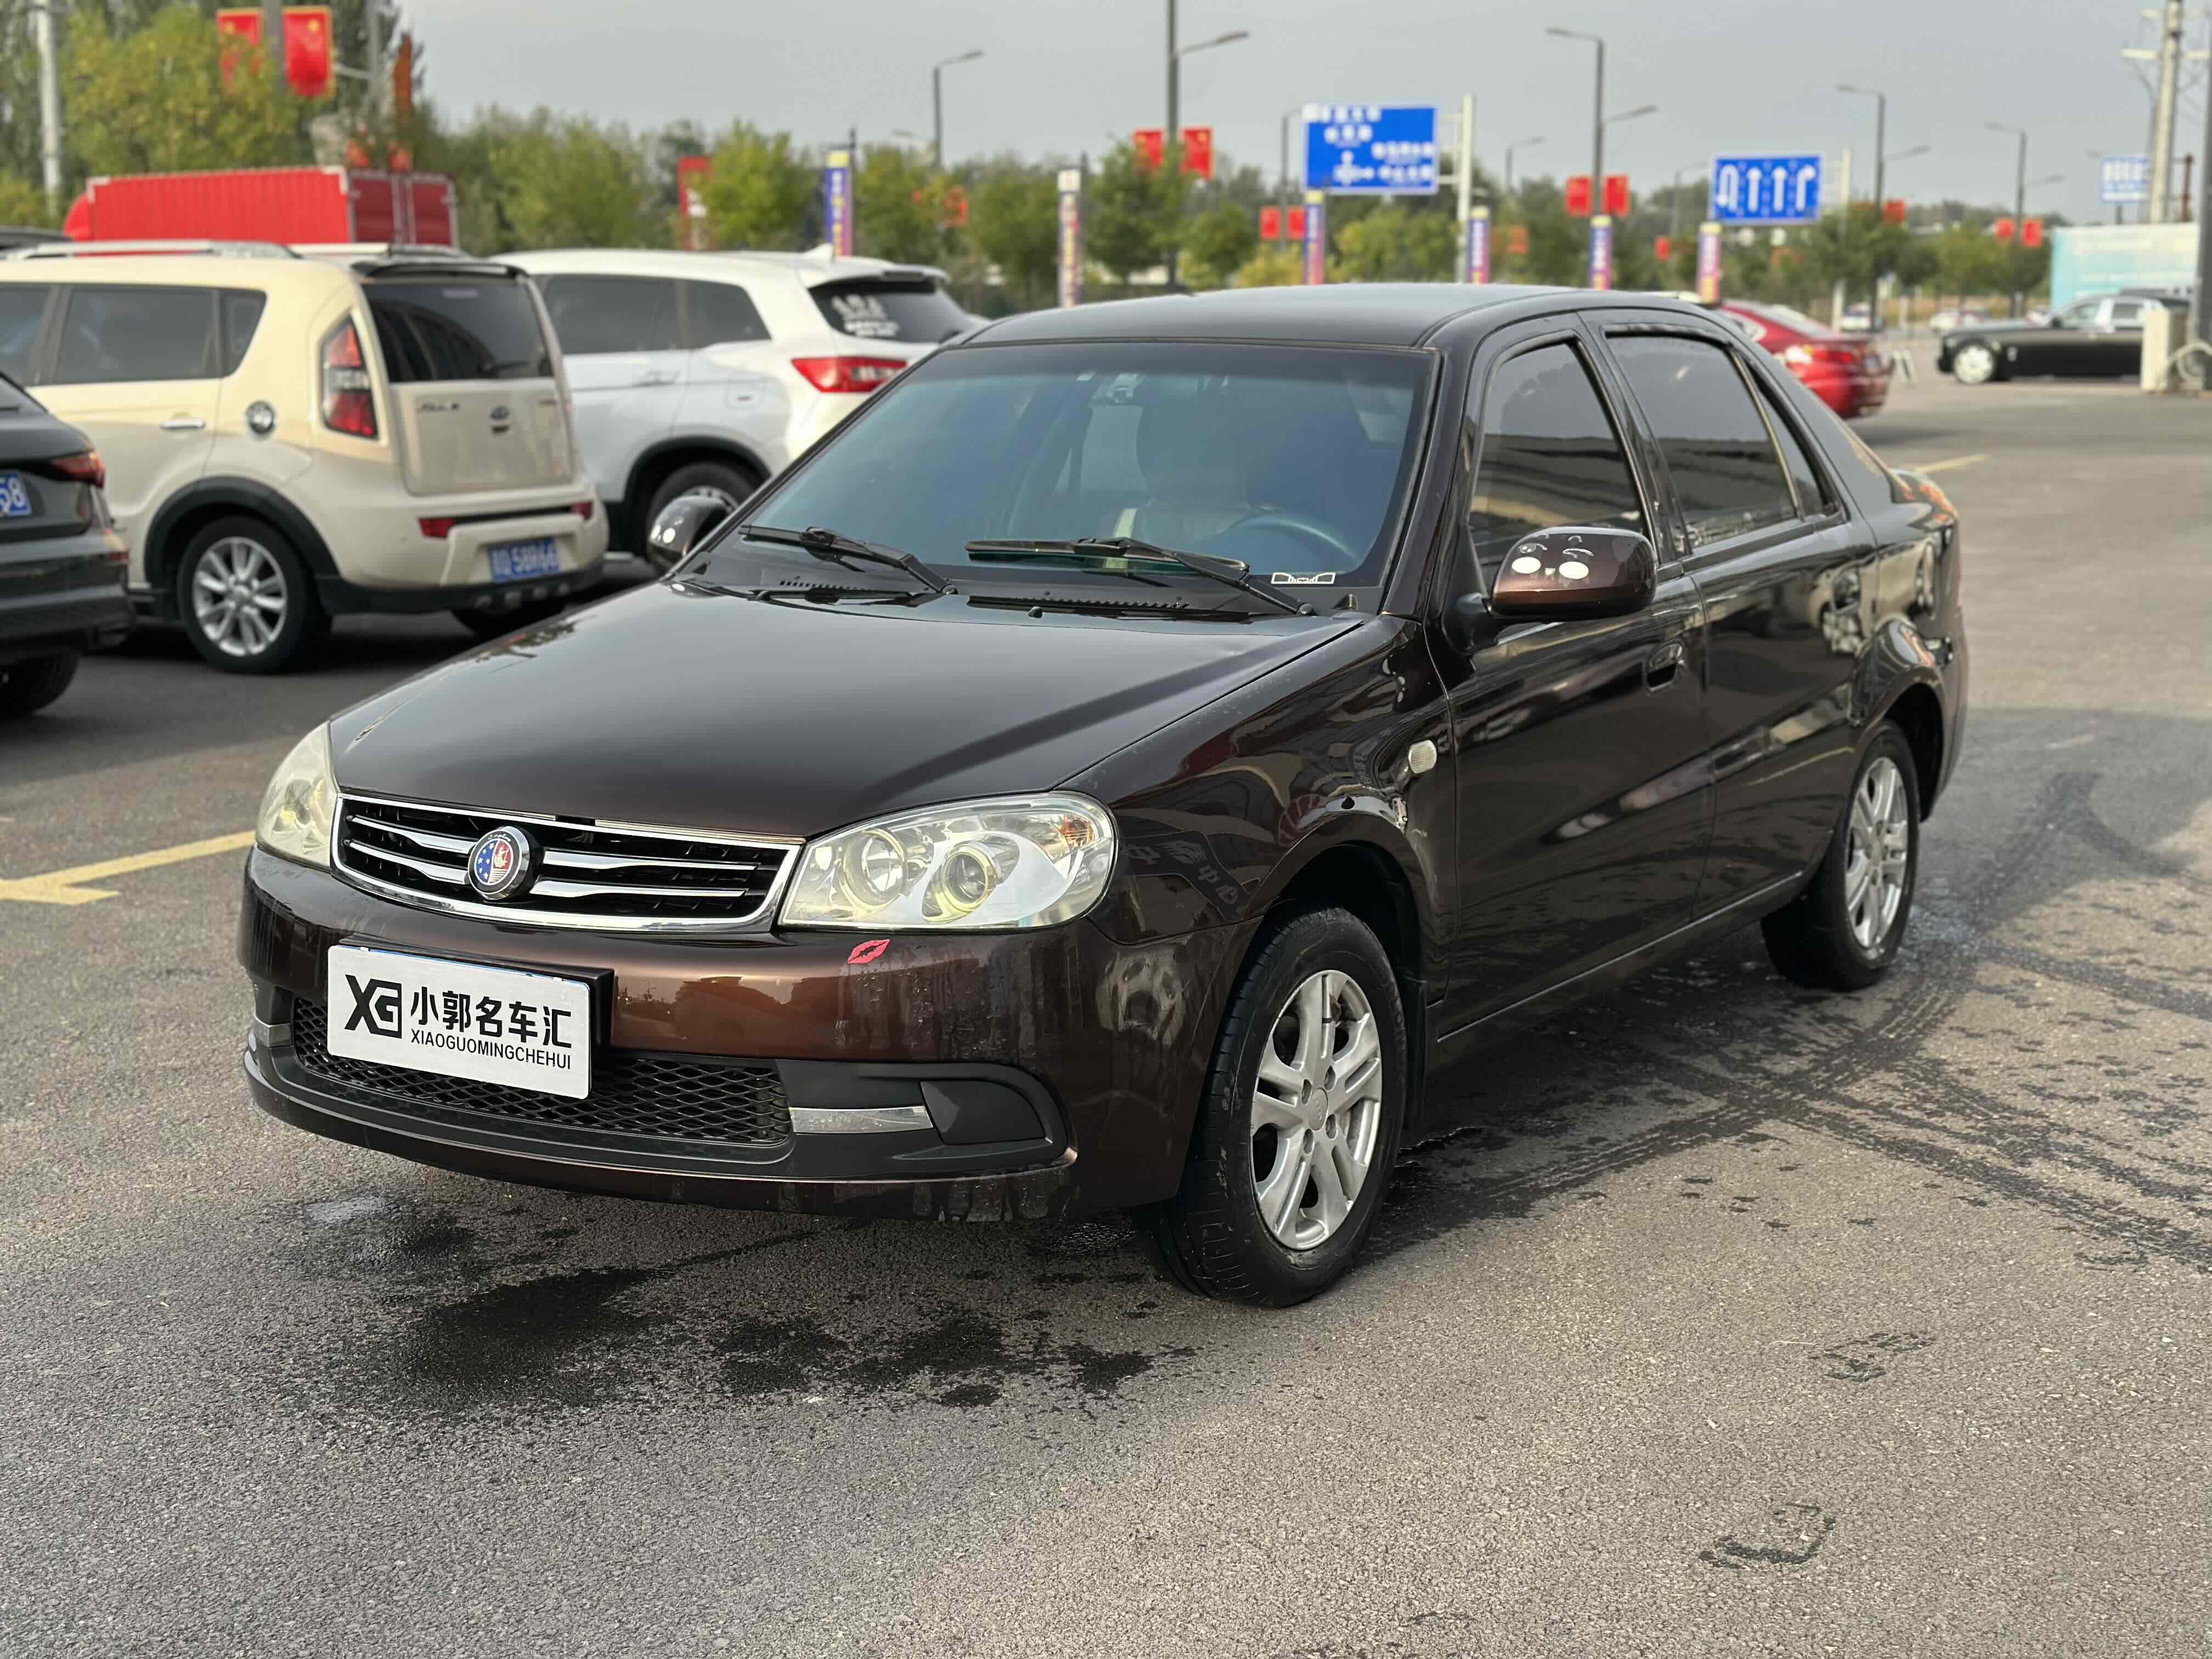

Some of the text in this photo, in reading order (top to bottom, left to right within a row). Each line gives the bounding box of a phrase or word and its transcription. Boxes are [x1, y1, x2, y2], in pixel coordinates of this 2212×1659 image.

[410, 986, 572, 1049] 小郭名车汇
[411, 1029, 571, 1070] XIAOGUOMINGCHEHUI
